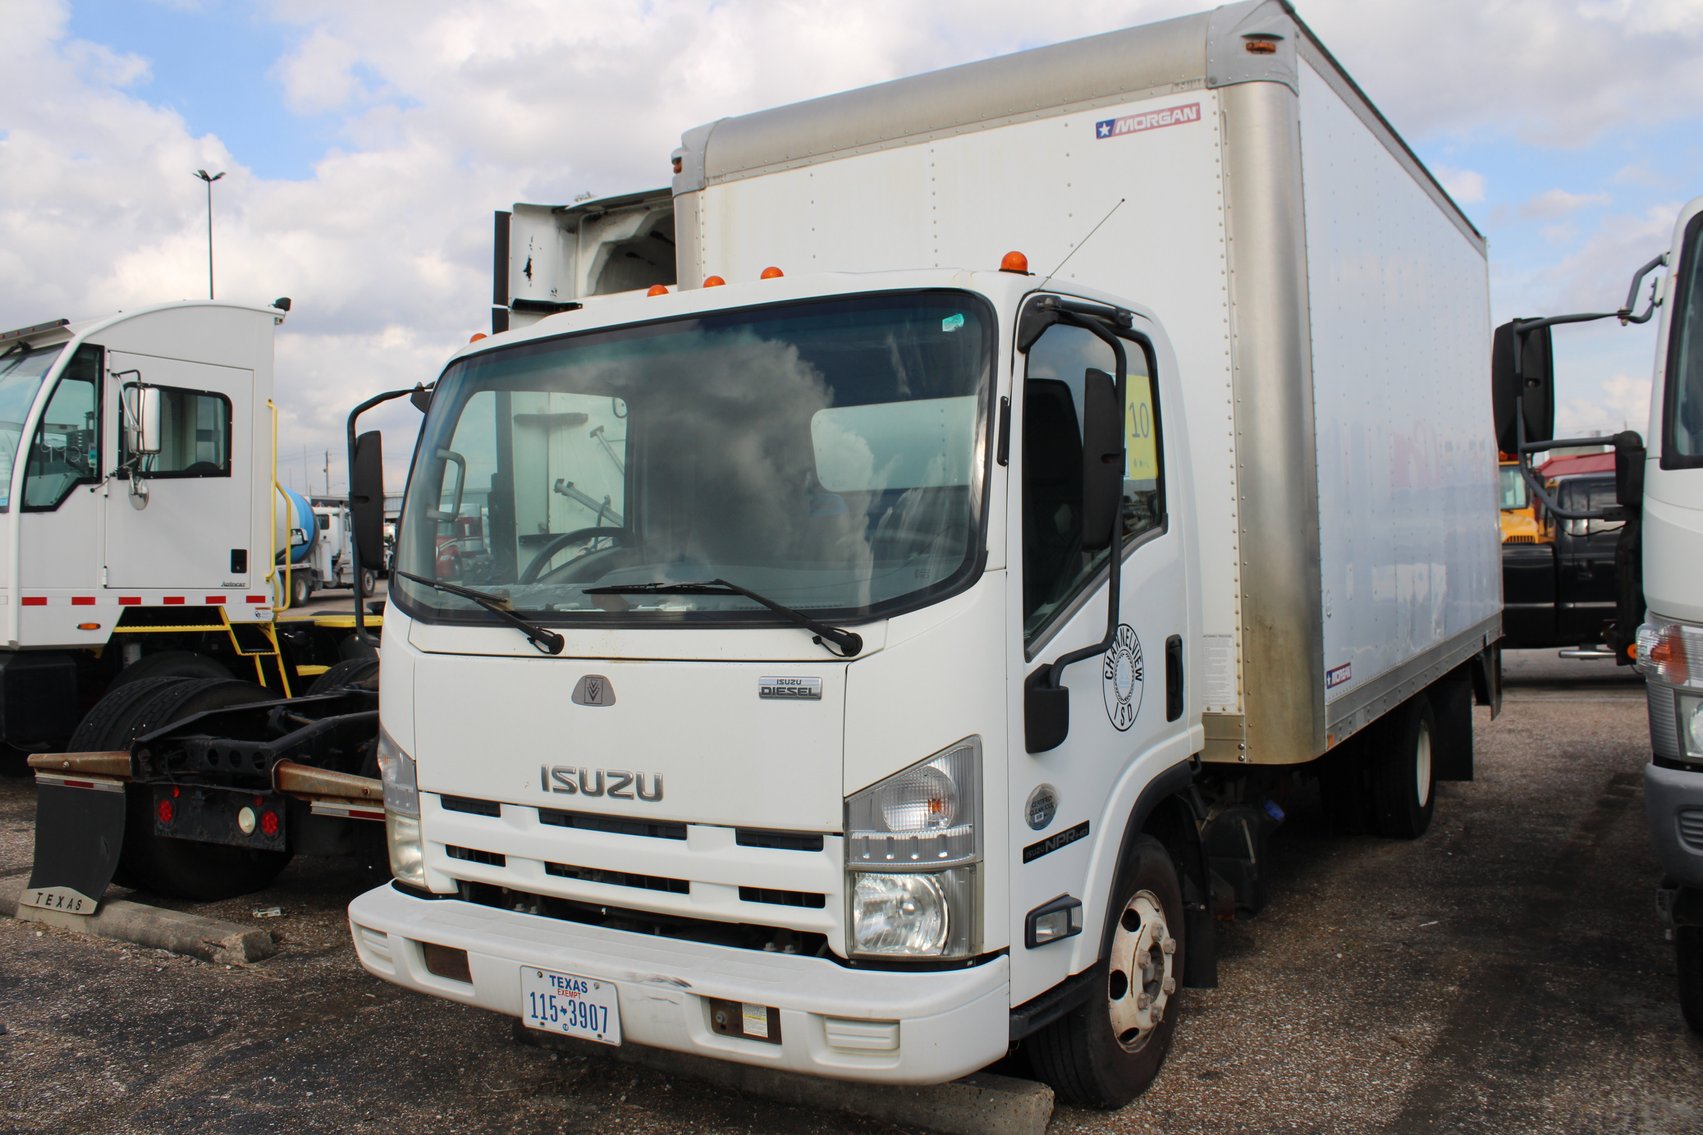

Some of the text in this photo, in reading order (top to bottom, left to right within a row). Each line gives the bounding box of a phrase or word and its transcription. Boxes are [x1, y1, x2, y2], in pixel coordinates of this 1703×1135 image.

[1115, 106, 1198, 133] MORGAN
[1129, 402, 1150, 438] 10
[761, 686, 818, 697] DIESEL
[1114, 702, 1132, 726] ISD
[541, 763, 664, 802] ISUZU
[1045, 829, 1076, 852] NPR
[36, 892, 82, 910] TEXAS
[549, 975, 588, 994] TEXAS
[557, 989, 582, 1000] EXEMPT
